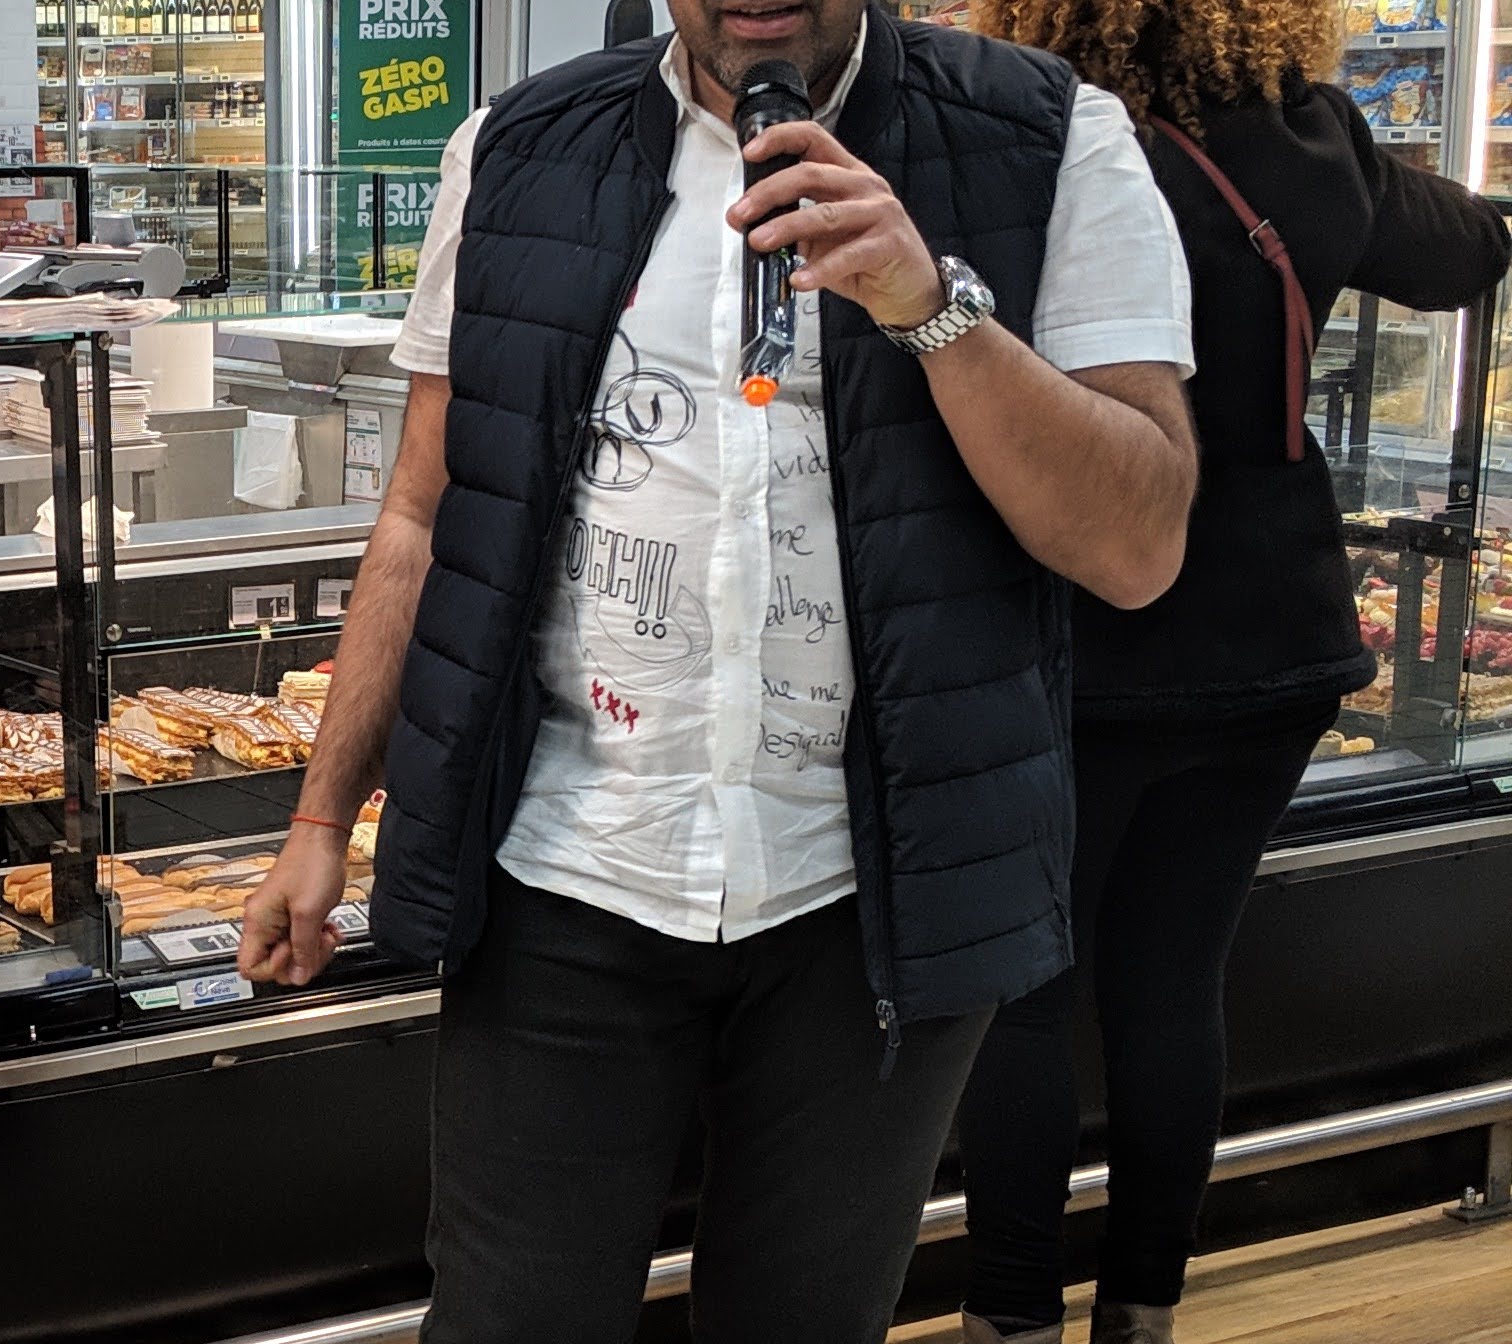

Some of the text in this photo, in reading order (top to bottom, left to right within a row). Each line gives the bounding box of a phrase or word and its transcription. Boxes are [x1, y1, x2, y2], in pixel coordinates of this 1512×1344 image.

[359, 19, 451, 40] RÉDUITS
[359, 55, 445, 96] ZÉRO
[363, 81, 450, 120] GASPI
[358, 139, 391, 147] Produits
[400, 138, 422, 146] dates
[423, 138, 448, 146] courte
[357, 211, 433, 228] RDUIT
[764, 575, 842, 644] allenge
